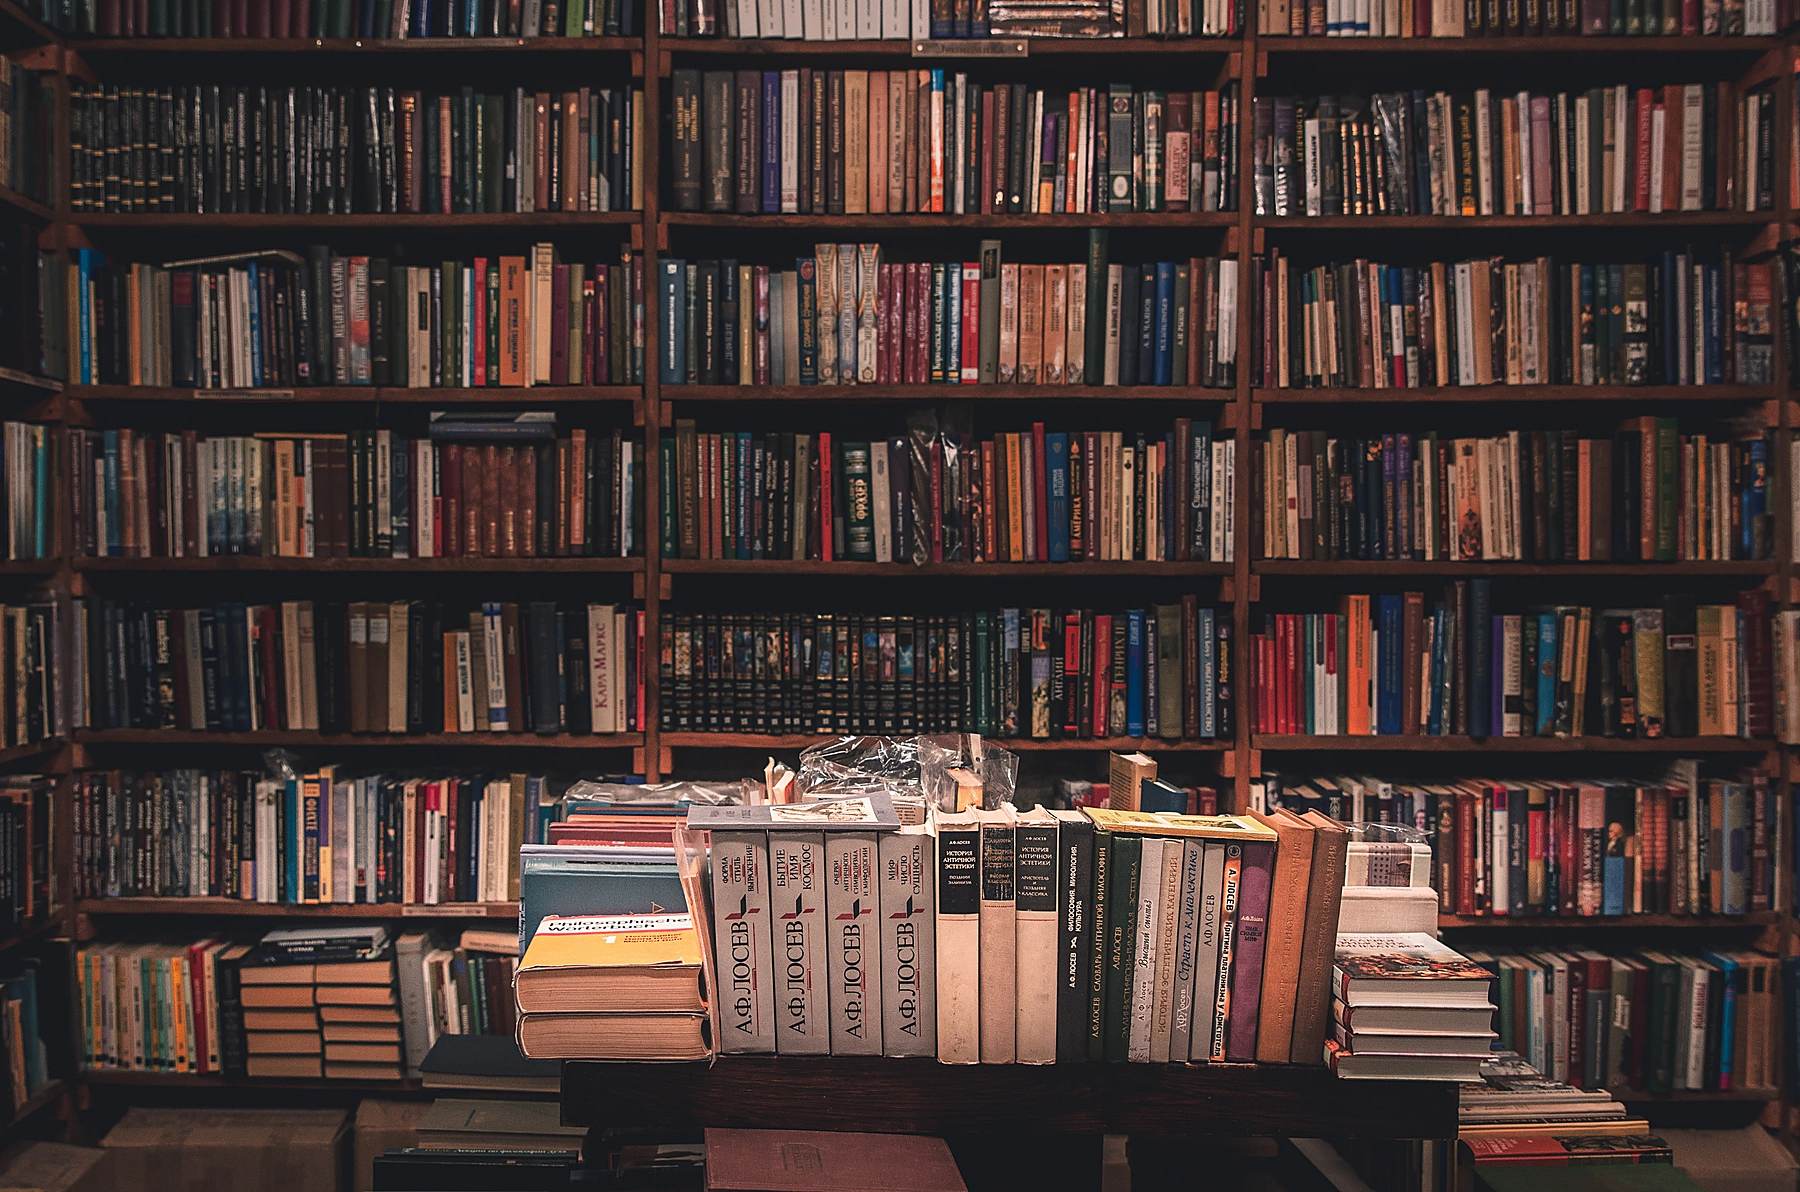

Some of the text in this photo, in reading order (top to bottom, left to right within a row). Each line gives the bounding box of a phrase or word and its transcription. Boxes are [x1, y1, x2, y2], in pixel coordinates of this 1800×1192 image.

[1639, 104, 1650, 195] LANTERNA NOSTRA
[932, 272, 942, 296] Англии
[948, 272, 959, 370] Королевская семья Англии
[932, 324, 942, 370] Королевская
[985, 364, 992, 372] 2
[856, 479, 868, 520] ФРЭЗЕР
[1191, 462, 1200, 508] Становление
[1072, 497, 1081, 538] АМЕРИКА
[459, 665, 468, 694] МОЛОДОЙ
[1055, 657, 1063, 700] АНГЛИИ
[1114, 637, 1125, 683] ГЕНРИХ
[1219, 641, 1229, 683] Реформация
[746, 845, 754, 892] ВЫРАЖЕНИЕ
[776, 850, 786, 887] БЫТИЕ
[789, 855, 798, 880] ИМЯ
[802, 844, 811, 890] КОСМОС
[1069, 844, 1077, 887] МИФОЛОГИЯ.
[1097, 847, 1106, 901] ФИЛОСОФИИ
[1226, 869, 1237, 911] А. ЛОСЕВ
[1281, 842, 1301, 970] ЭСТЕТИКА ВОЗРОЖДЕНИЯ
[1315, 844, 1336, 975] ЭСТЕТИКА ВОЗРОЖДЕНИЯ
[1094, 904, 1104, 952] АНТИЧНОЙ
[1138, 899, 1152, 969] Высший синтез
[1178, 933, 1192, 981] Страсть
[1186, 850, 1198, 919] диалектике
[1223, 922, 1232, 954] Критика
[1157, 857, 1178, 1033] ИСТОРИЯ ЭСТЕТИЧЕСКИХ КАТЕГОРИЙ
[731, 922, 752, 1035] А.Ф. ЛОСЕВ
[786, 921, 805, 1035] А.Ф. ЛОСЕВ
[843, 925, 862, 1038] А.Ф. ЛОСЕВ
[896, 923, 916, 1036] А.Ф. ЛОСЕВ
[1093, 954, 1102, 991] СЛОВАРЬ
[1121, 911, 1135, 1039] ЭЛЛИНИСТИЧЕСКИ-РИМСКАЯ
[1219, 956, 1229, 1002] платонизма
[1214, 1011, 1223, 1057] Аристотеля
